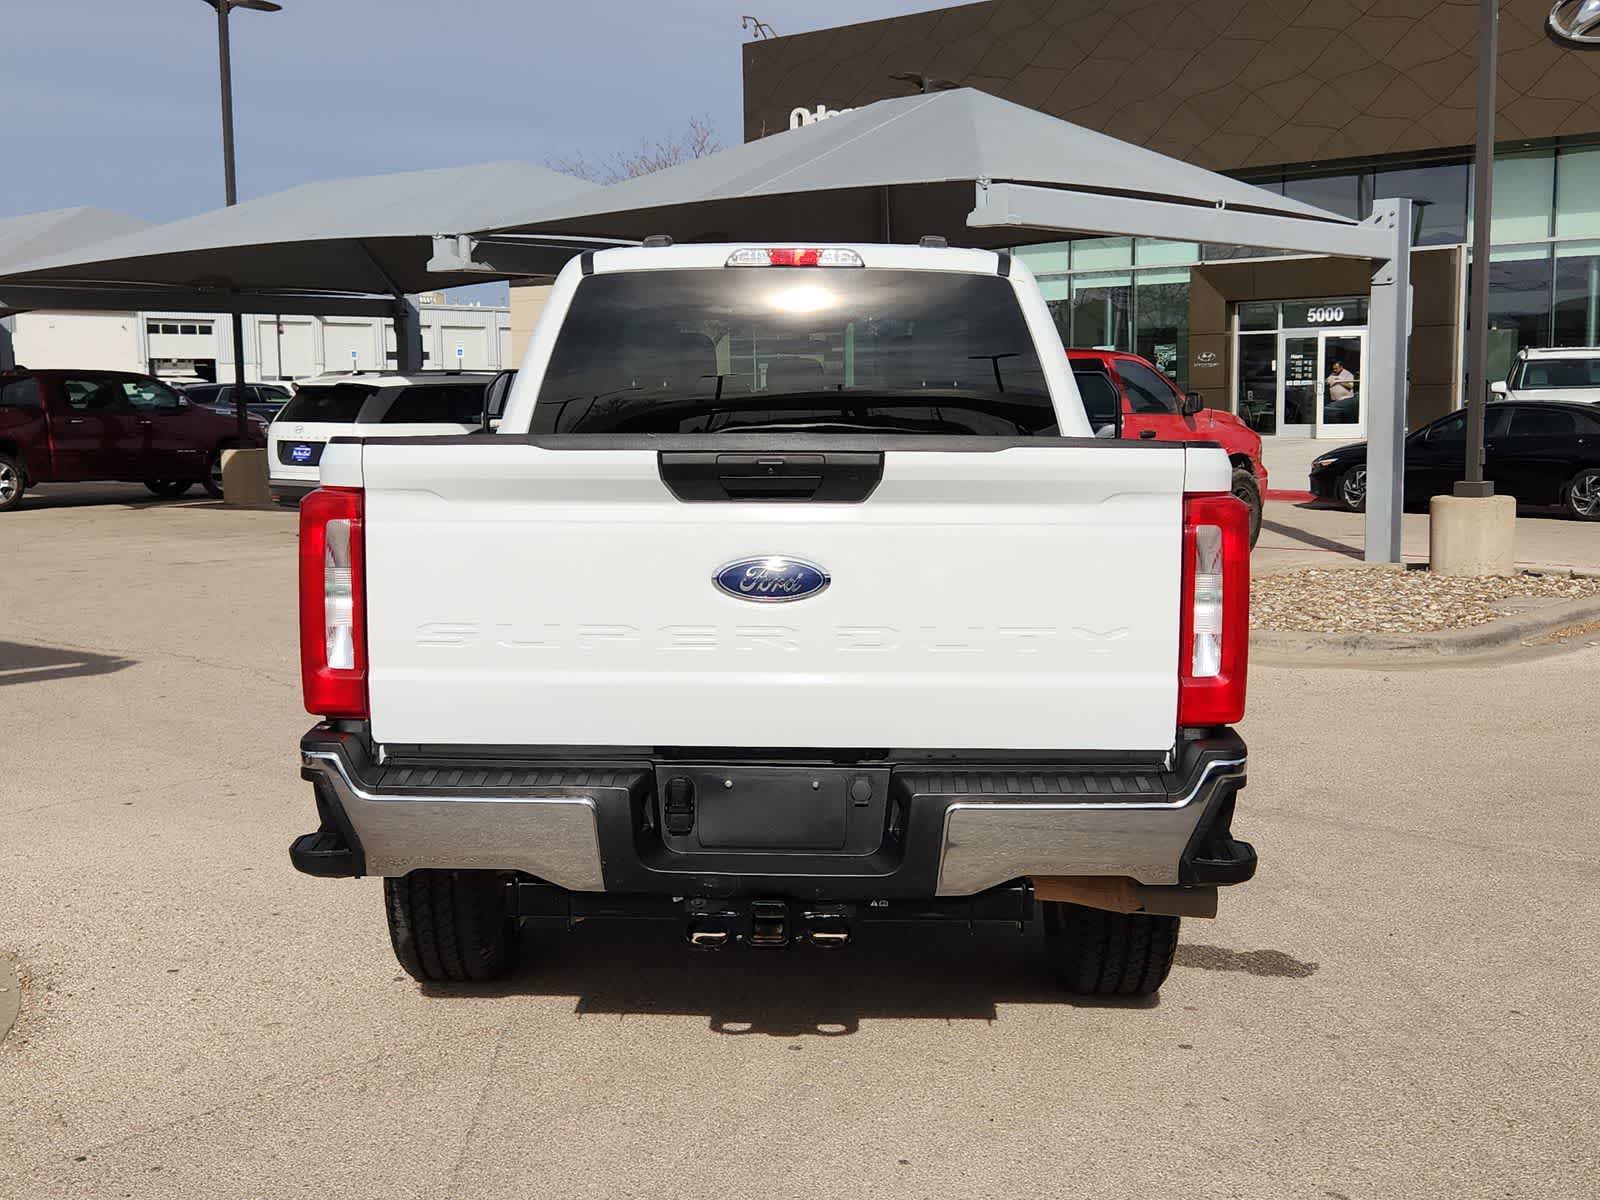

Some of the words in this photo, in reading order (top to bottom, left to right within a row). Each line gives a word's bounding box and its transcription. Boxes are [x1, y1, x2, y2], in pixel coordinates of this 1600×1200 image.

[1306, 307, 1344, 323] 5000
[738, 564, 804, 592] Ford
[415, 621, 800, 650] SUPER
[833, 625, 1131, 652] DUTY
